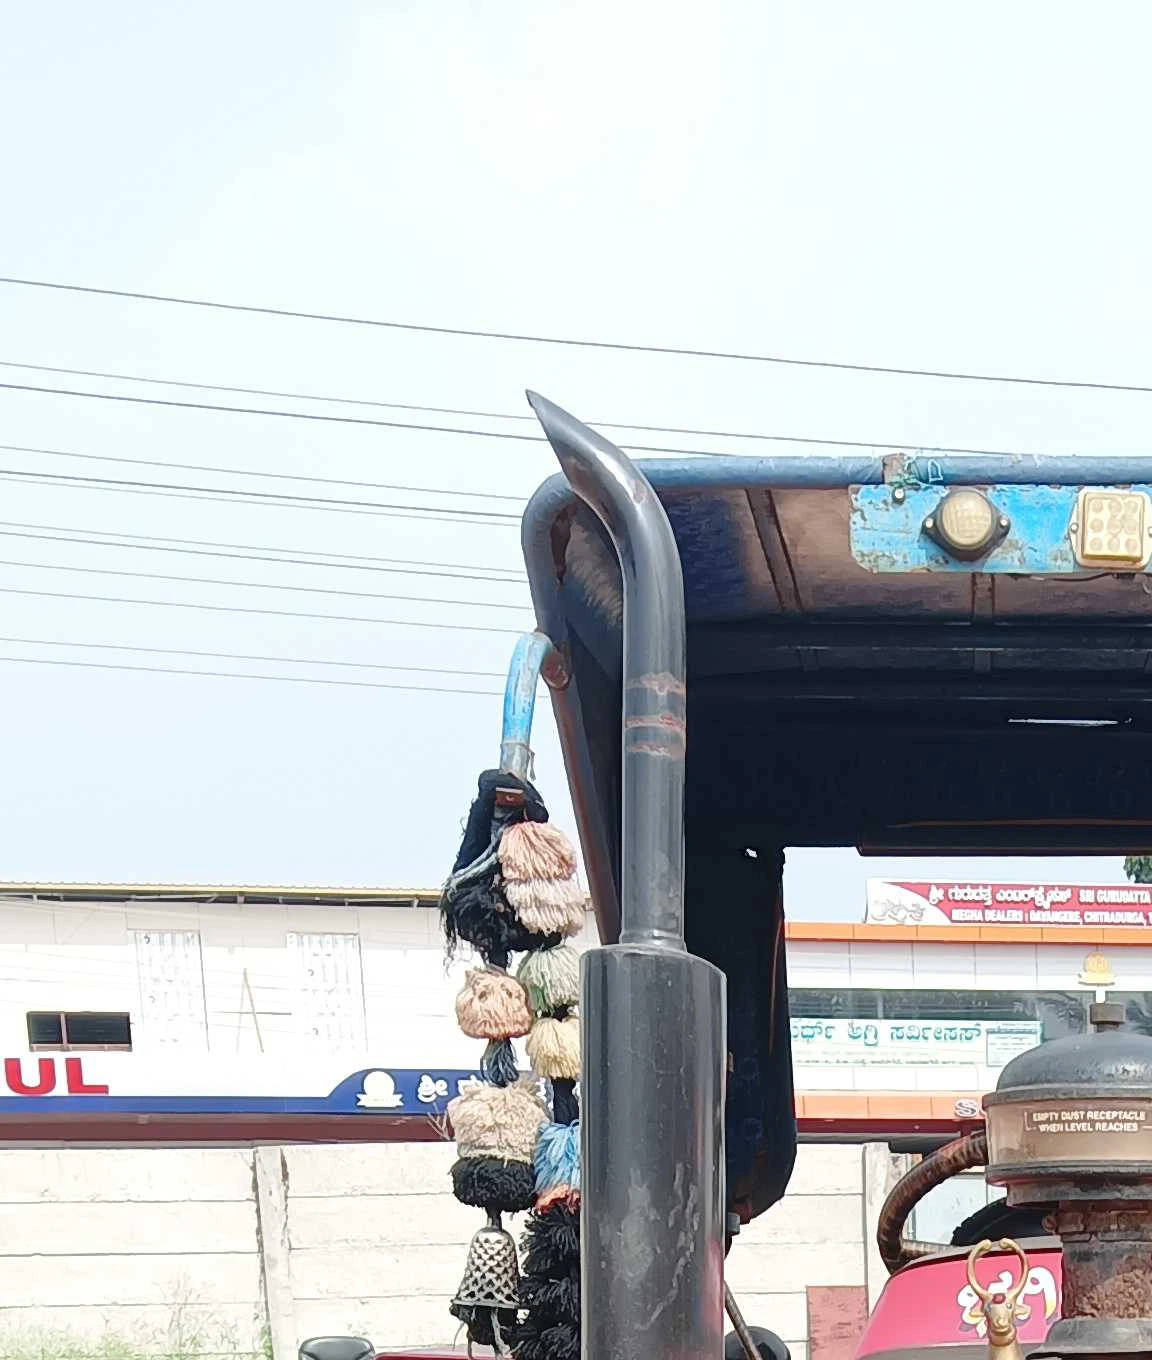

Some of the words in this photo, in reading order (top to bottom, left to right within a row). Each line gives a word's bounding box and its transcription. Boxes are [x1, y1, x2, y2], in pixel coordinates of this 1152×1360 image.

[1079, 889, 1095, 902] SRI
[1097, 890, 1150, 904] GURUDATTA
[4, 1058, 109, 1096] UL
[1032, 1112, 1059, 1122] EMPTY
[1061, 1111, 1085, 1121] DUST
[1087, 1110, 1147, 1121] RECEPTACLE
[1038, 1123, 1063, 1133] WHEN
[1065, 1123, 1093, 1132] LEVEL
[1095, 1122, 1139, 1132] REACHES
